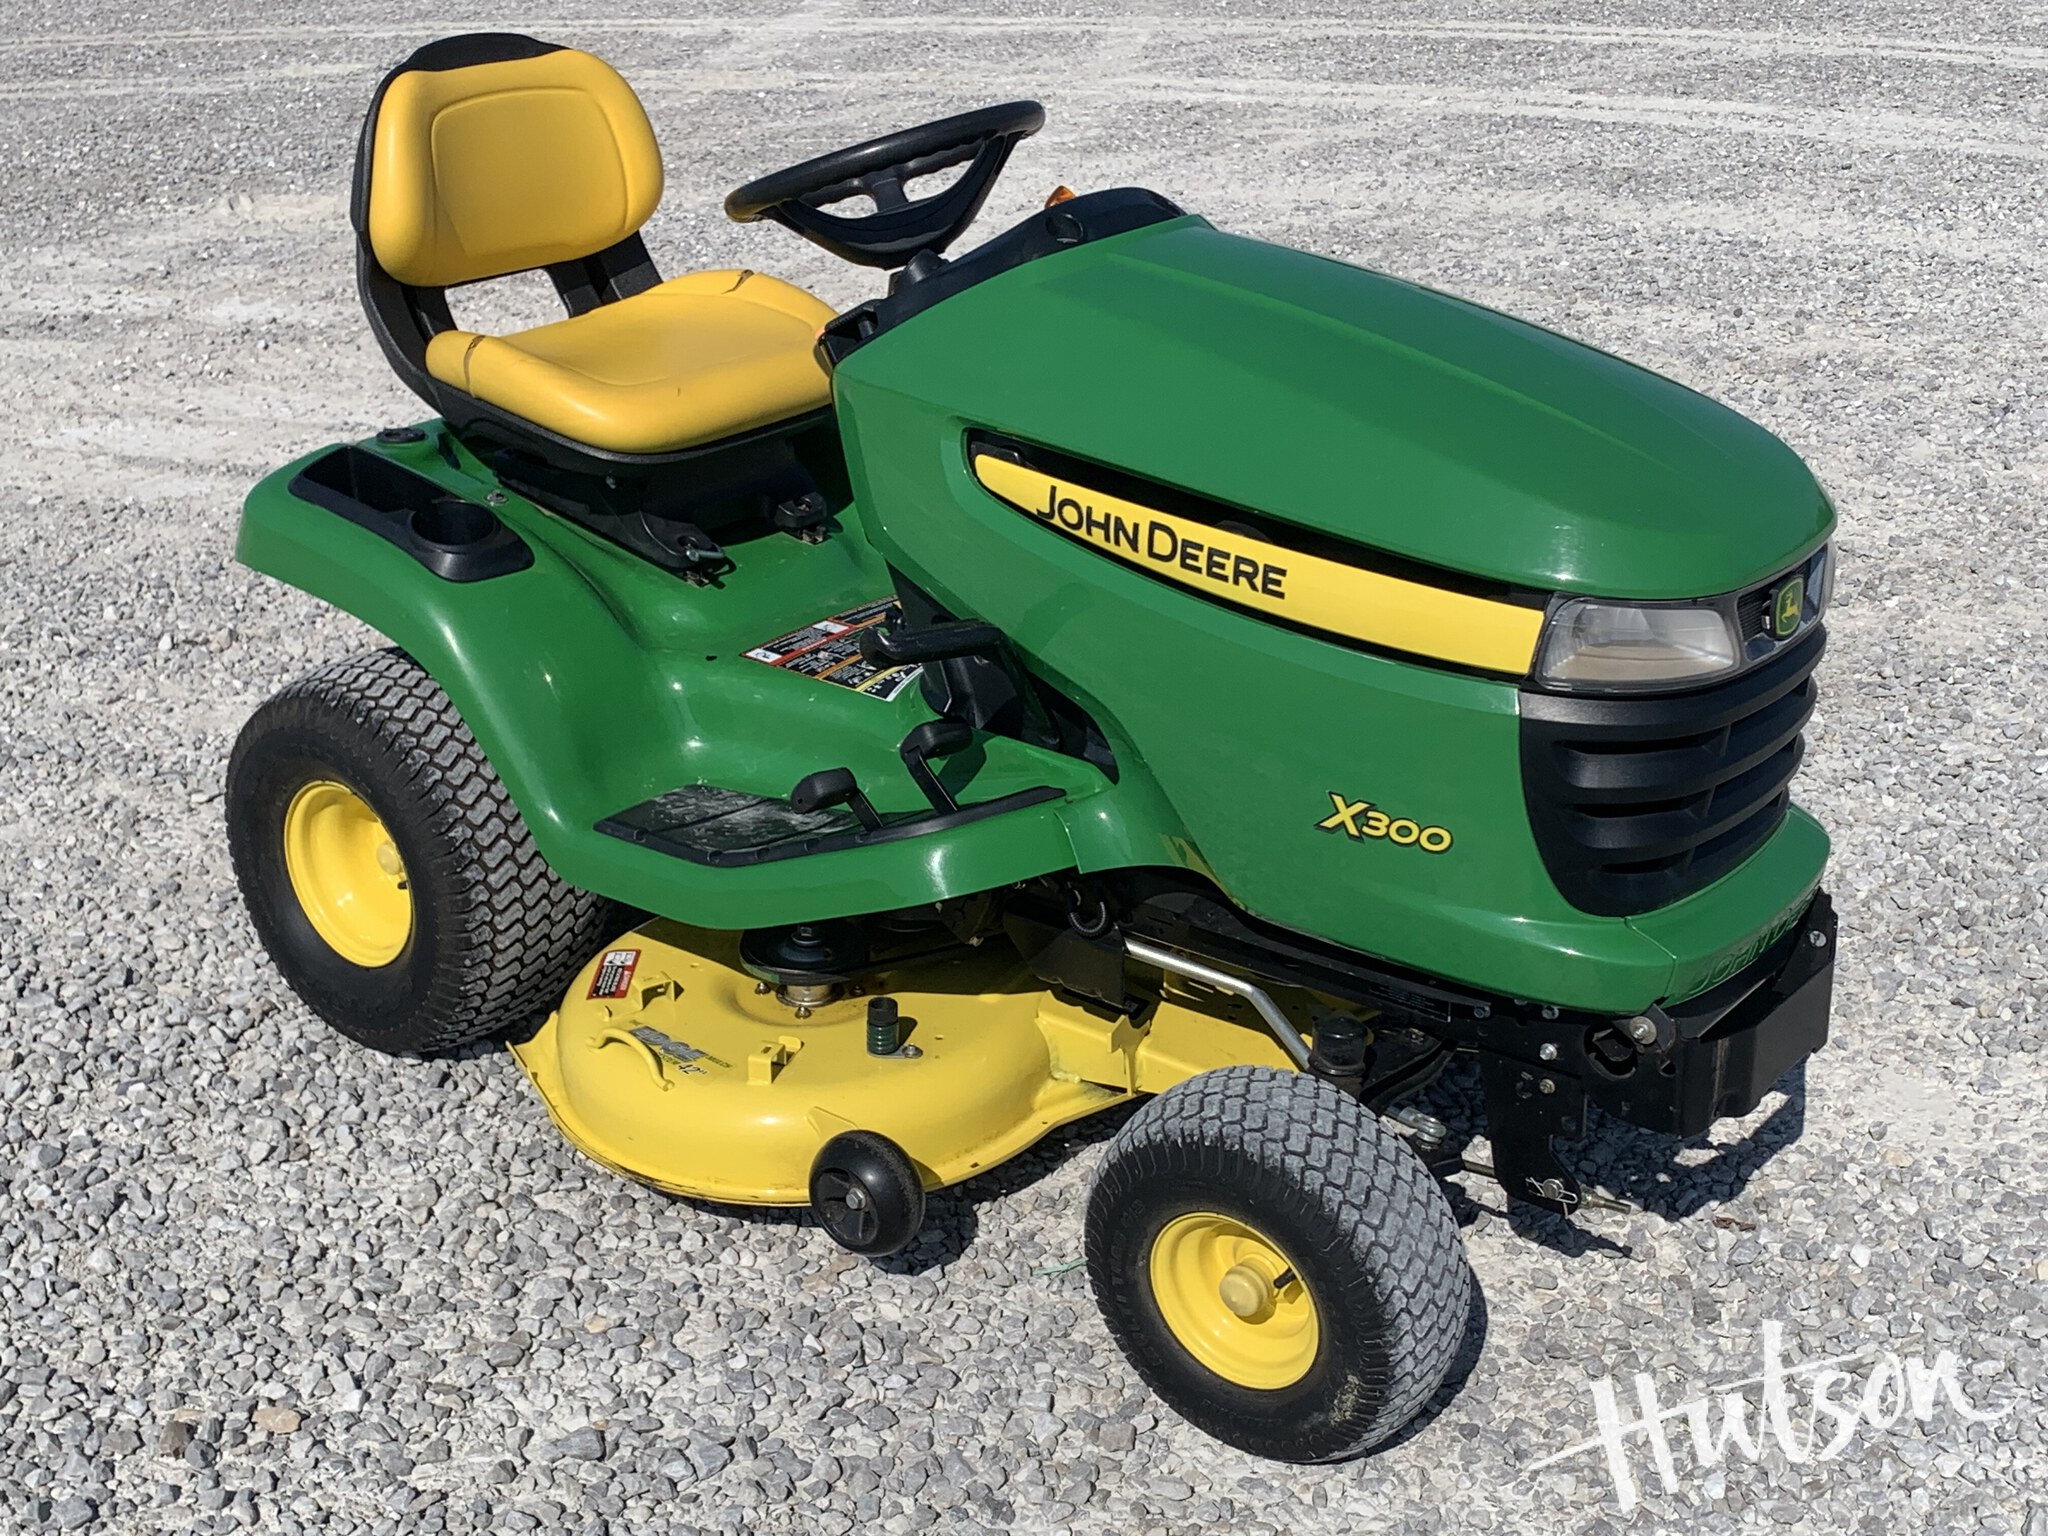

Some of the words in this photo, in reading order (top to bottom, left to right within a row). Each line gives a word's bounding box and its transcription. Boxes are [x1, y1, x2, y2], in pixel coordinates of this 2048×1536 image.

[1036, 485, 1140, 553] JOHN
[1147, 520, 1287, 600] DEERE
[1314, 791, 1453, 854] X300
